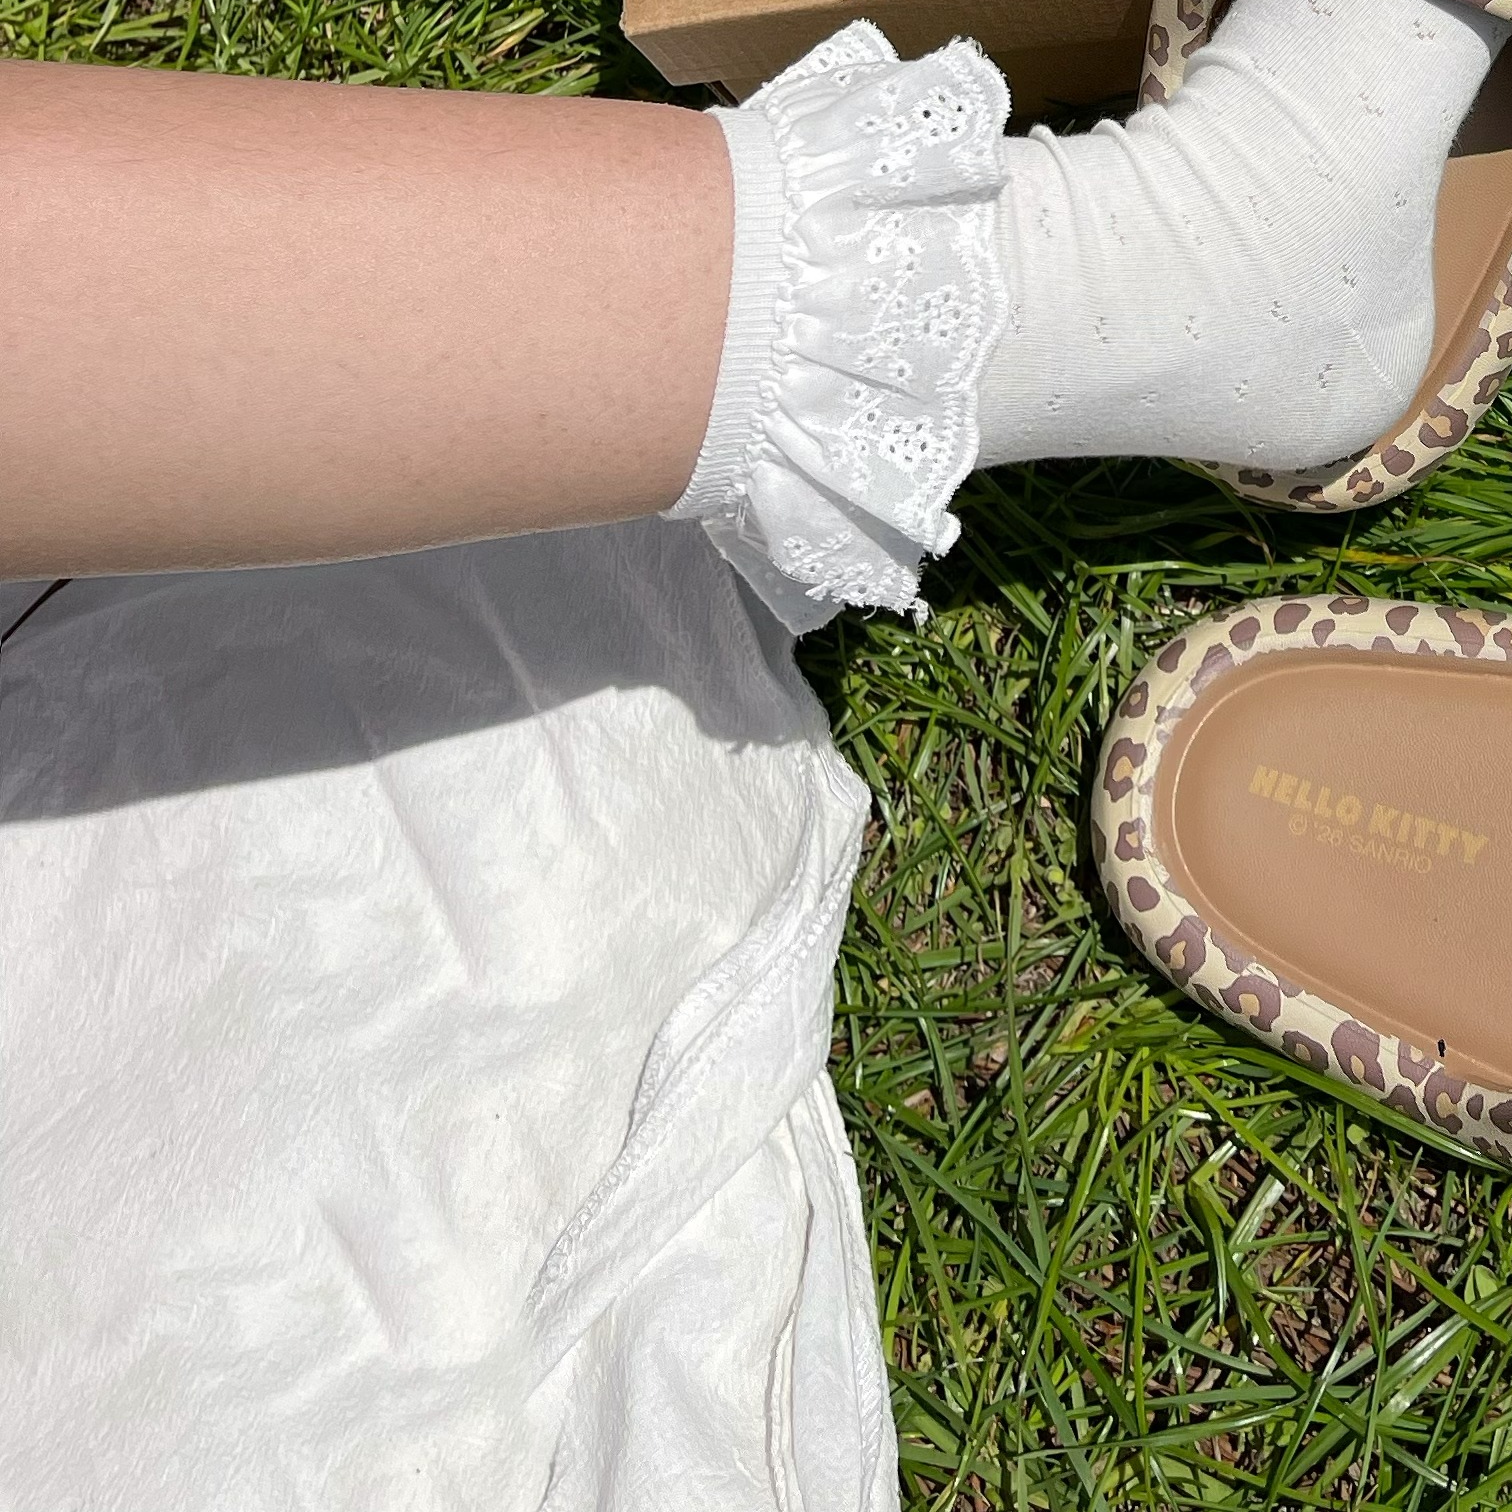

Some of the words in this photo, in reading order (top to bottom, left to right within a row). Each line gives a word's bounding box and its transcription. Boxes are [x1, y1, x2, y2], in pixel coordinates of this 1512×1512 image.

[1249, 764, 1363, 826] HELLO
[1368, 802, 1490, 866] KITTY
[1350, 834, 1432, 874] SANRIO
